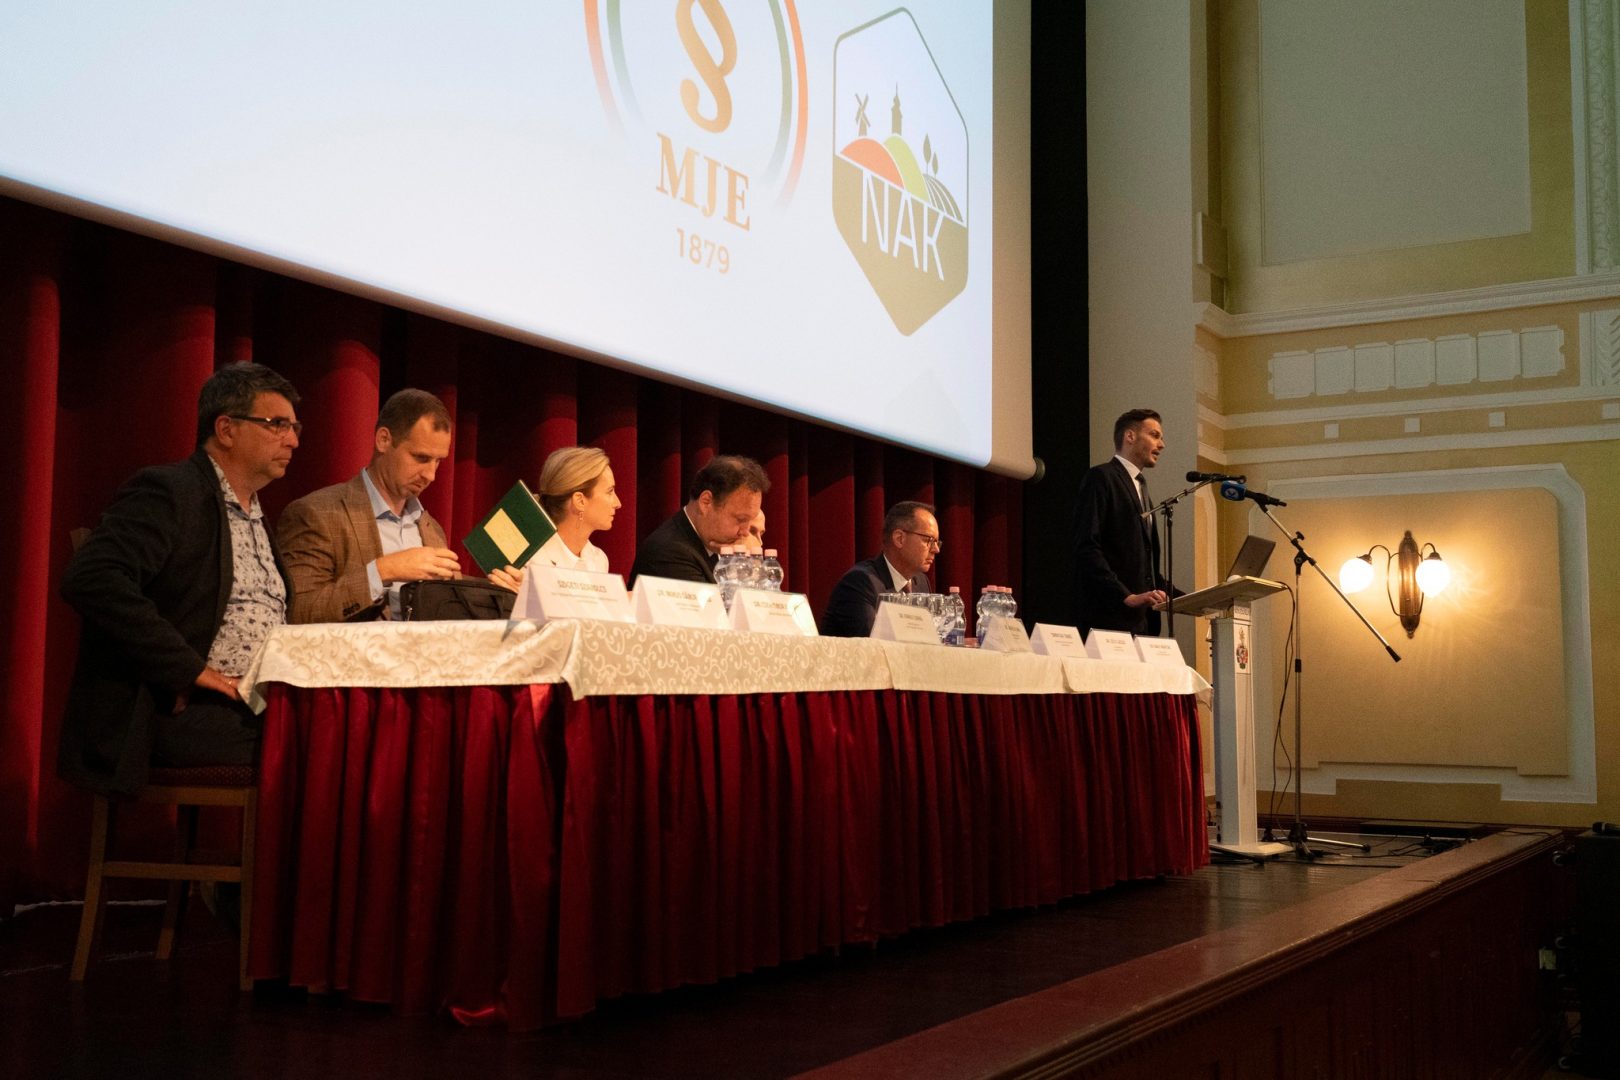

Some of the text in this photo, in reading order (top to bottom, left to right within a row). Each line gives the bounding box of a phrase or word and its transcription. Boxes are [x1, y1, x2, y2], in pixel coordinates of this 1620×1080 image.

[656, 133, 750, 231] MJE
[862, 172, 944, 281] NAK
[677, 229, 730, 274] 1879
